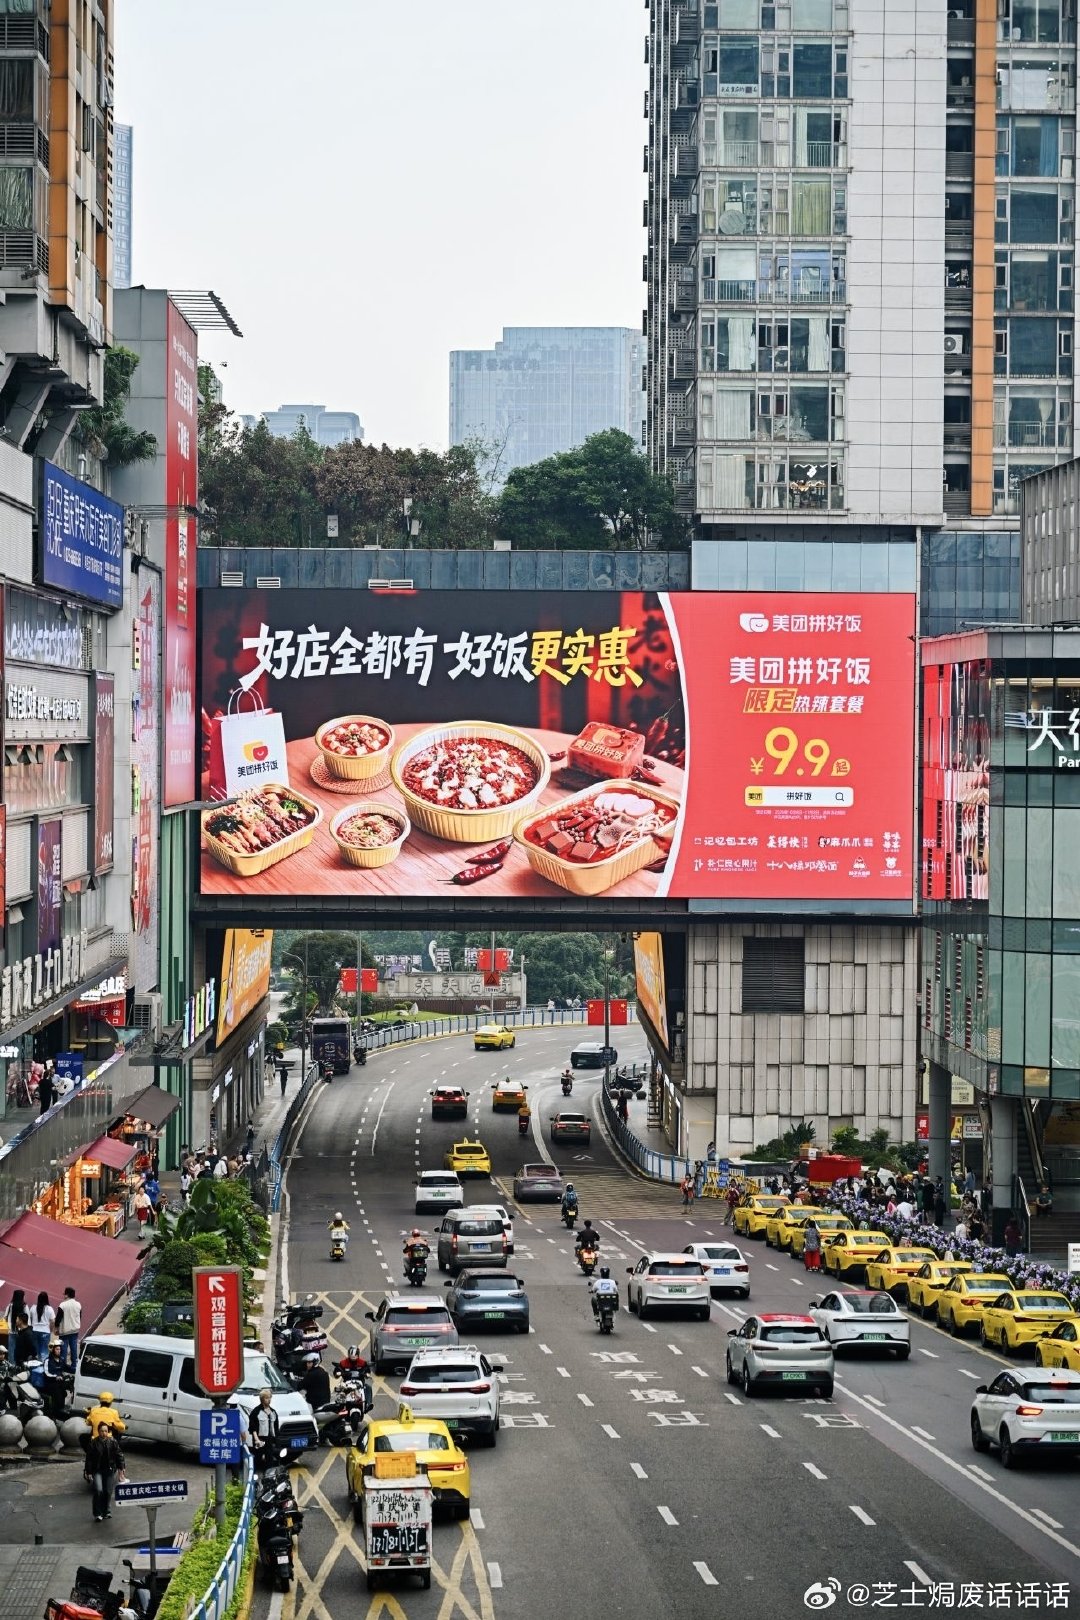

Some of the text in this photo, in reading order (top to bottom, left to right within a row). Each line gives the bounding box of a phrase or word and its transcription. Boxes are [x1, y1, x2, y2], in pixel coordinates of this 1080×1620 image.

[772, 614, 862, 633] 美团拼好饭
[238, 622, 644, 692] 好店全都有 好饭更实惠
[729, 656, 871, 685] 美团拼好饭
[744, 688, 864, 713] 限定热辣套餐
[237, 759, 279, 778] 美团拼好饭
[786, 792, 812, 801] 拼好饭
[211, 1296, 227, 1386] 观音桥好吃街
[211, 1412, 228, 1435] P
[209, 1448, 232, 1460] 车库
